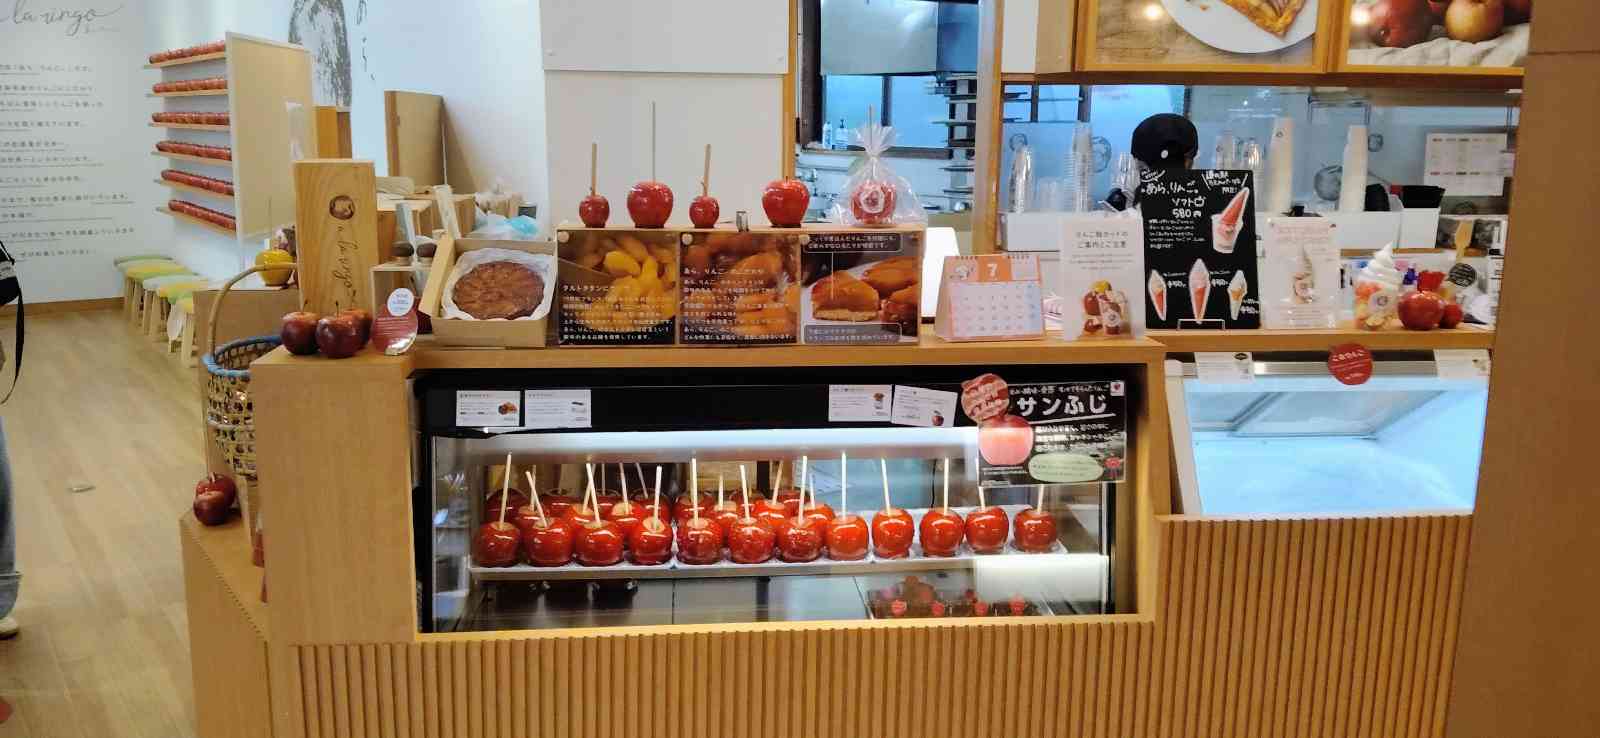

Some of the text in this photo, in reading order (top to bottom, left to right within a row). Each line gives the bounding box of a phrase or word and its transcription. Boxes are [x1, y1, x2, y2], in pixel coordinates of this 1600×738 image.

[987, 263, 998, 279] 7
[1016, 393, 1106, 417] サンふじ
